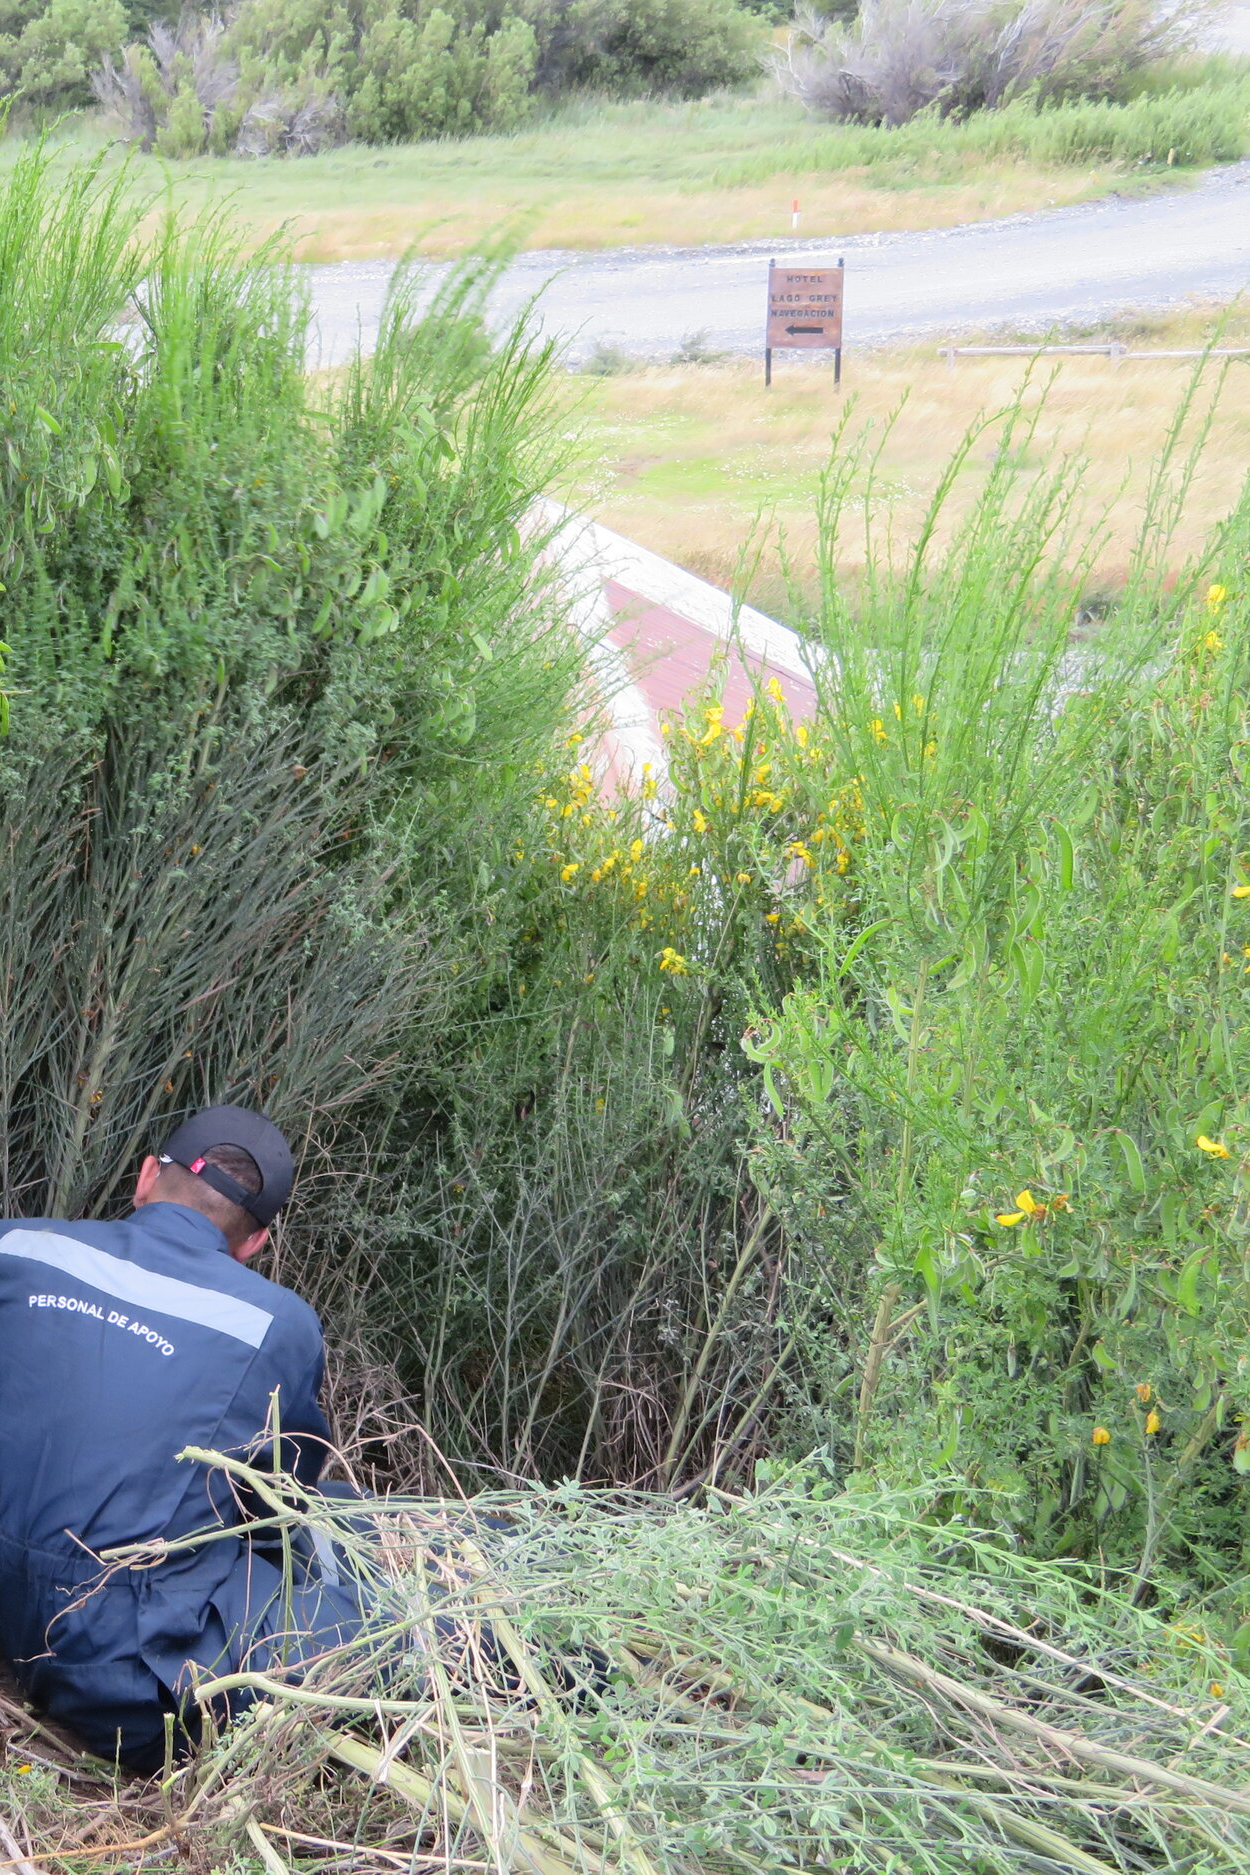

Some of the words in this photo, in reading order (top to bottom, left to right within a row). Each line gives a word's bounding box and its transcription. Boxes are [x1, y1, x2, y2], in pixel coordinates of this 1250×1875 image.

[786, 275, 823, 283] HOTEL
[771, 294, 801, 303] LAGO
[808, 294, 837, 303] GREY
[771, 309, 835, 318] NAVEGACION
[28, 1294, 104, 1320] PERSONAL
[106, 1310, 130, 1329] DE
[126, 1321, 175, 1357] APOYO
